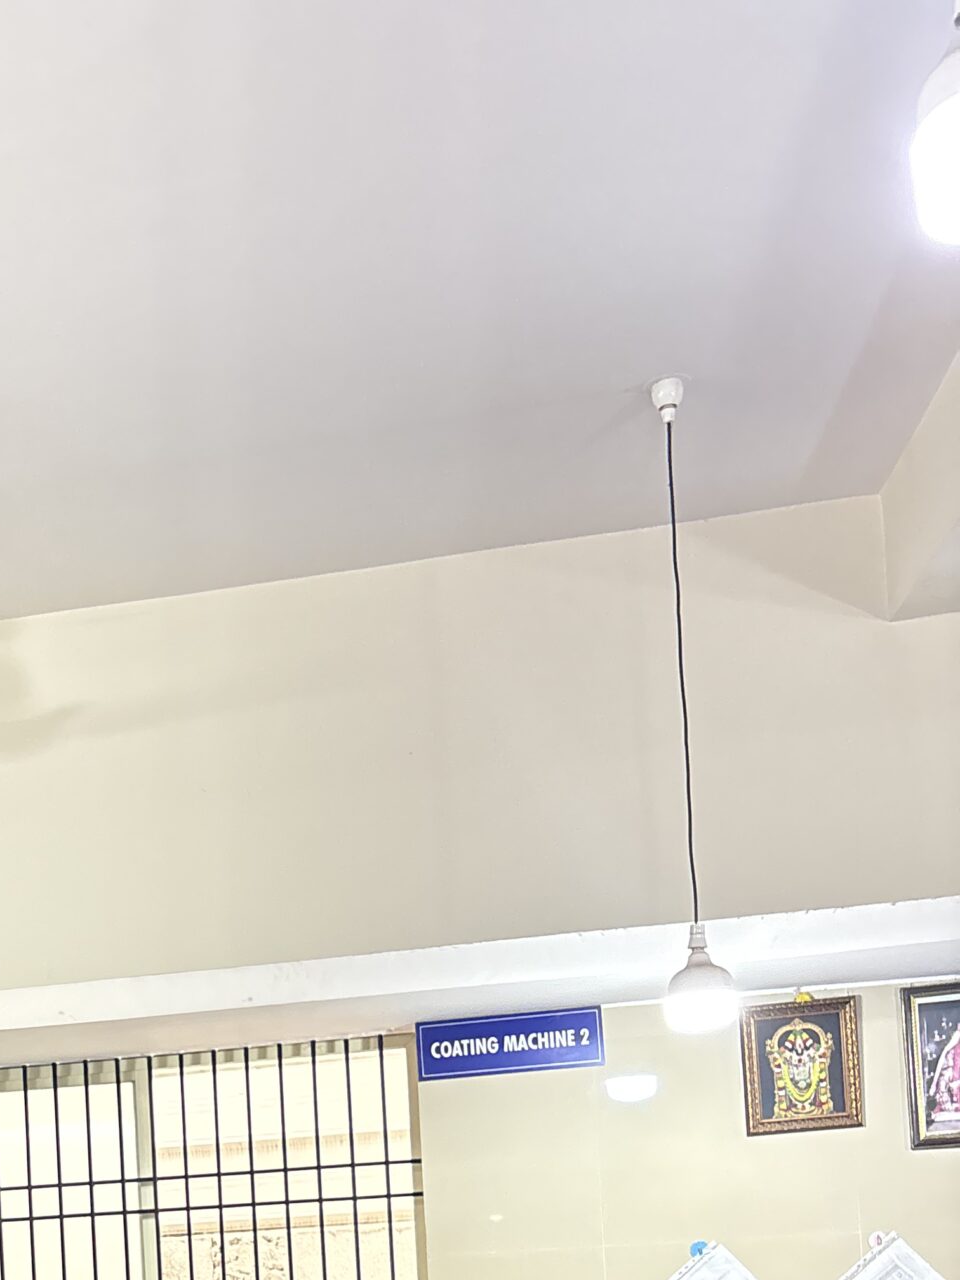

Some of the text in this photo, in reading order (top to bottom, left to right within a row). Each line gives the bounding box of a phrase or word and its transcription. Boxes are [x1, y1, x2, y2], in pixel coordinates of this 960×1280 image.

[430, 1028, 590, 1059] COATING MACHINE 2
